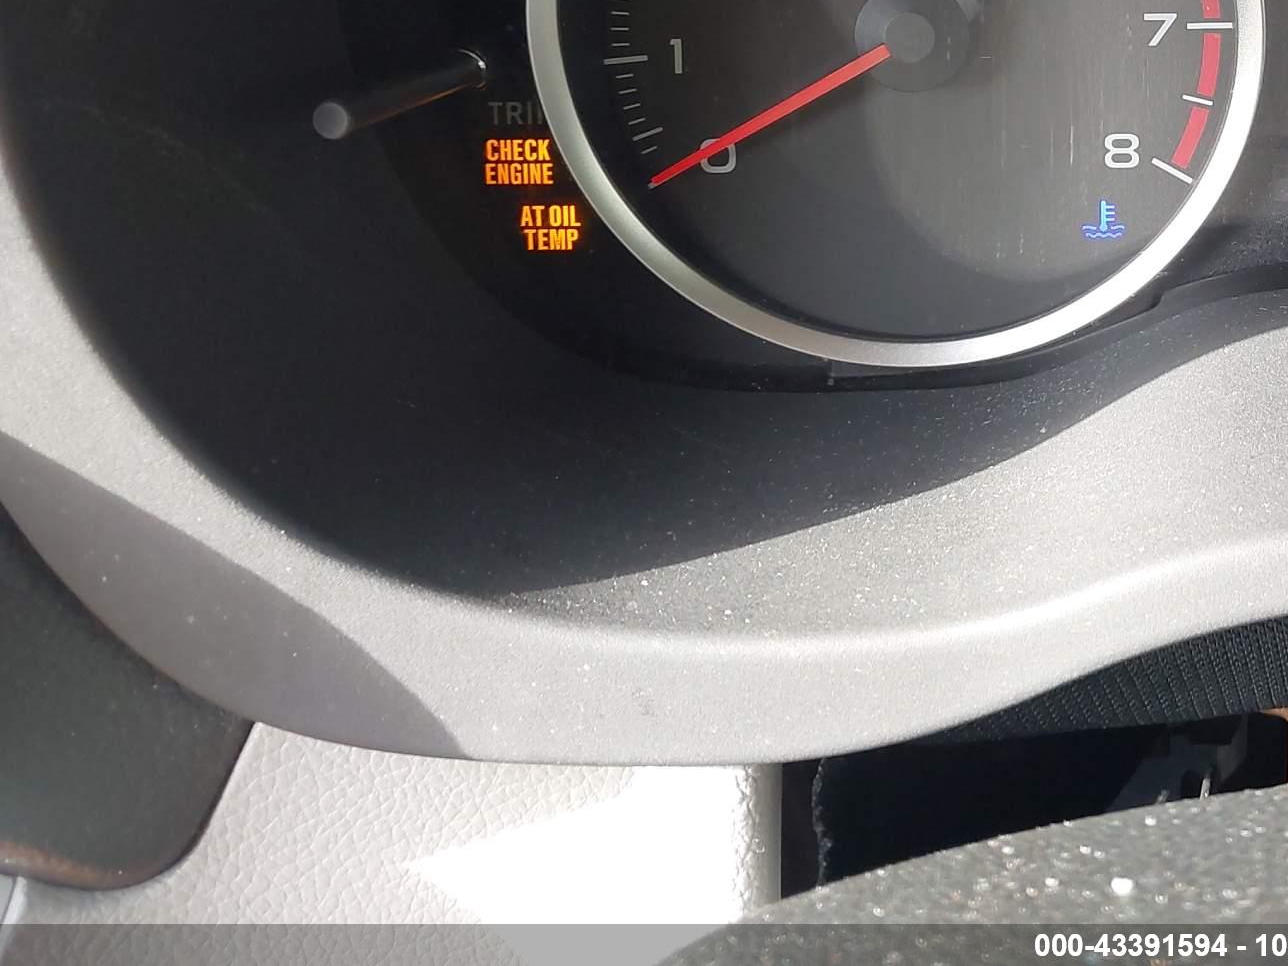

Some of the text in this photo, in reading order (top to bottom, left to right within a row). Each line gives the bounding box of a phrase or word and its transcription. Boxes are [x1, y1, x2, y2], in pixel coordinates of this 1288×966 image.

[1144, 14, 1177, 46] 7
[670, 39, 682, 73] 1
[487, 139, 550, 161] CHECK
[700, 138, 737, 173] 0
[1105, 134, 1139, 168] 8
[486, 163, 553, 184] ENGINE
[521, 205, 581, 226] AT OIL
[524, 229, 578, 250] TEMP
